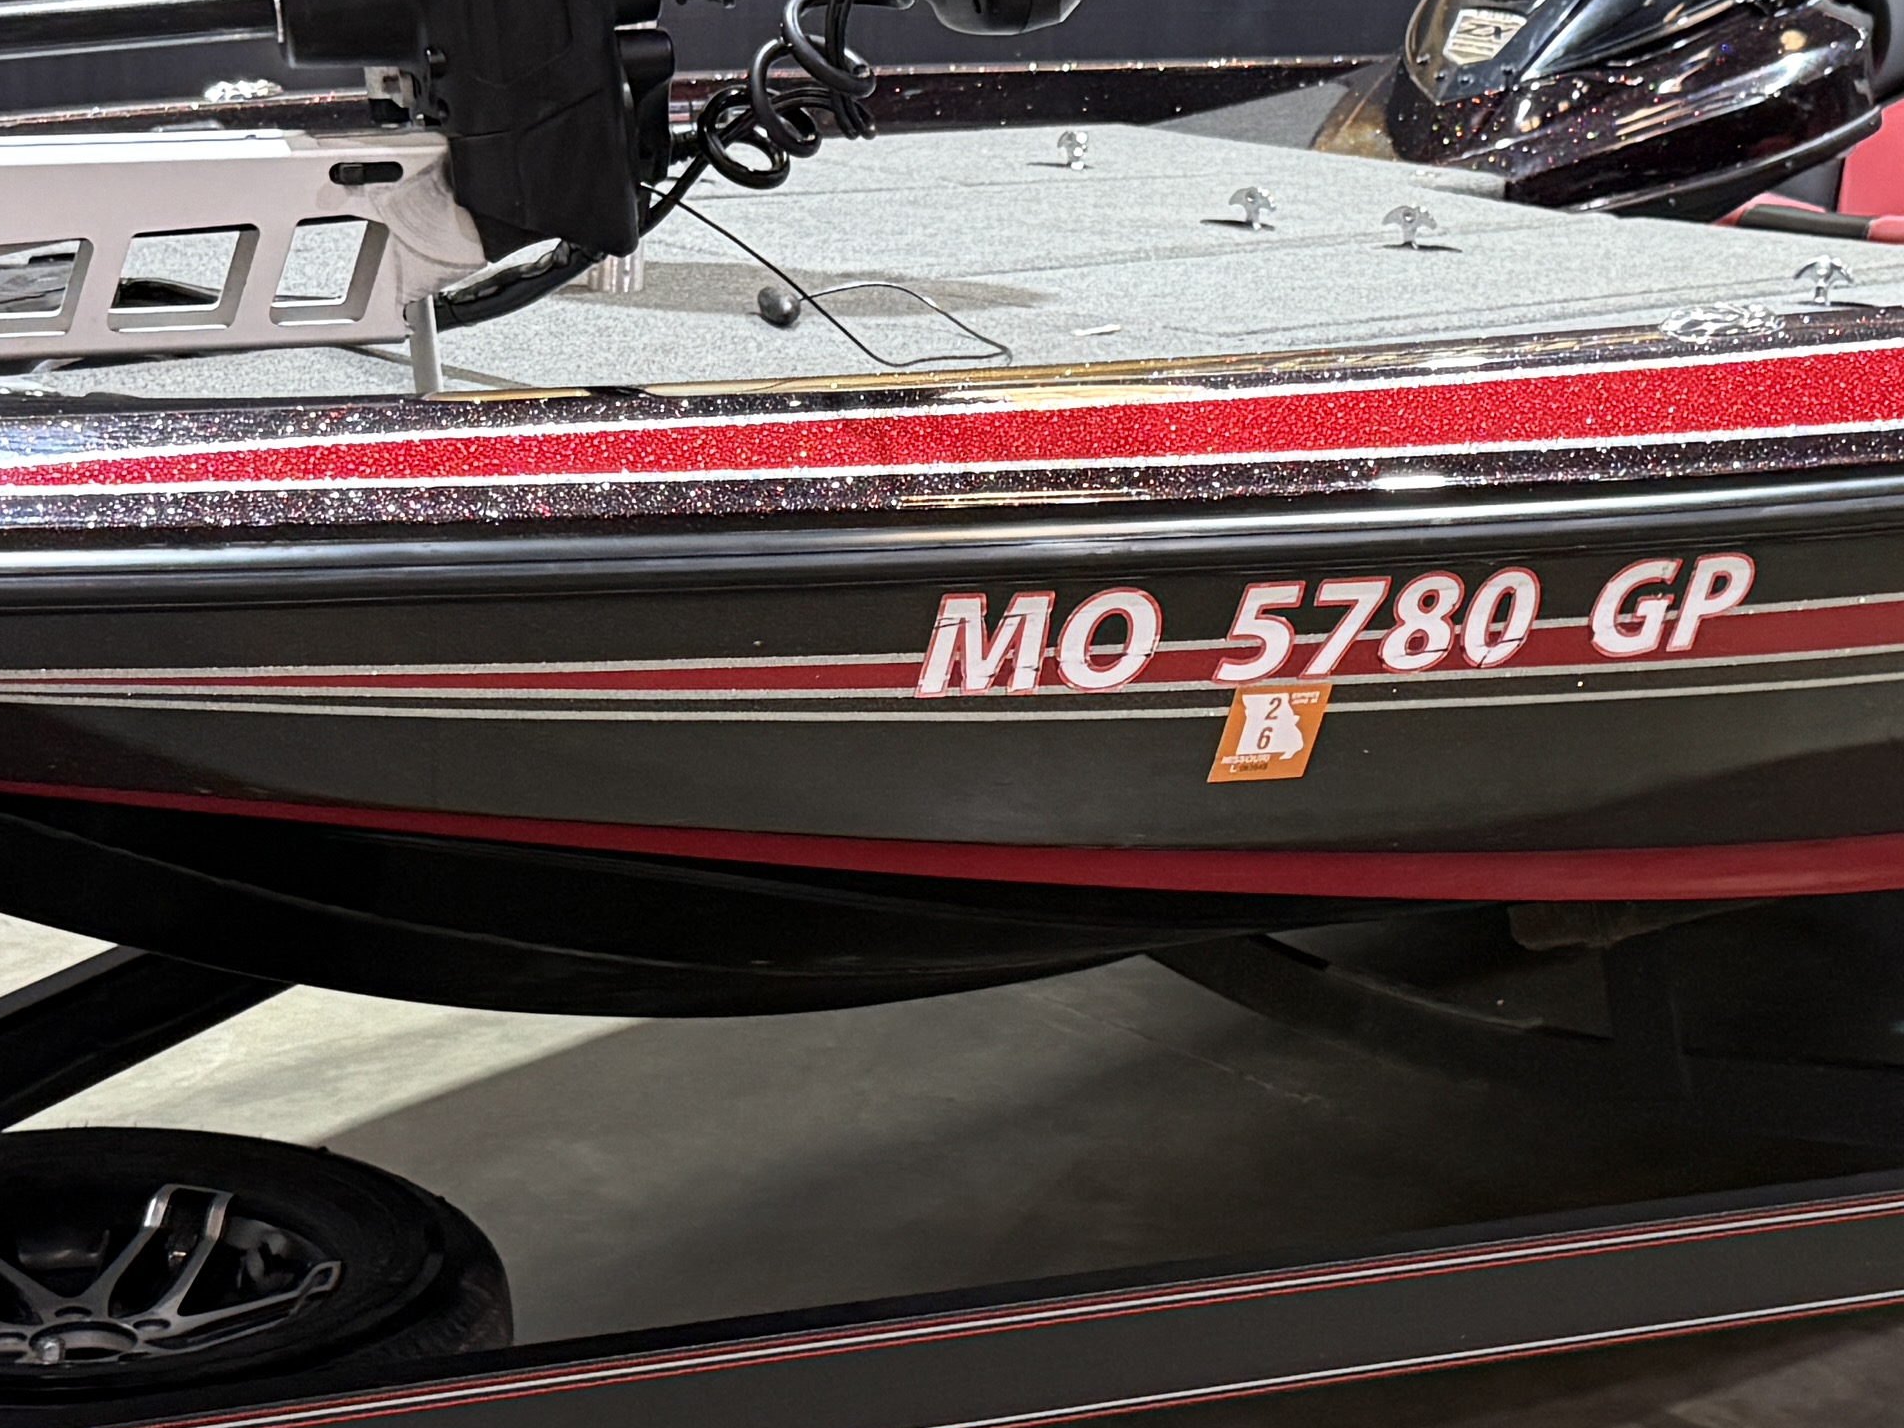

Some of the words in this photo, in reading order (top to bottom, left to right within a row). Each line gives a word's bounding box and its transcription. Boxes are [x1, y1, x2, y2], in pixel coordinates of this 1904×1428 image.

[913, 586, 1163, 699] MO
[1213, 567, 1542, 684] 5780
[1588, 552, 1756, 658] GP
[1264, 696, 1283, 721] 2
[1255, 725, 1274, 750] 6
